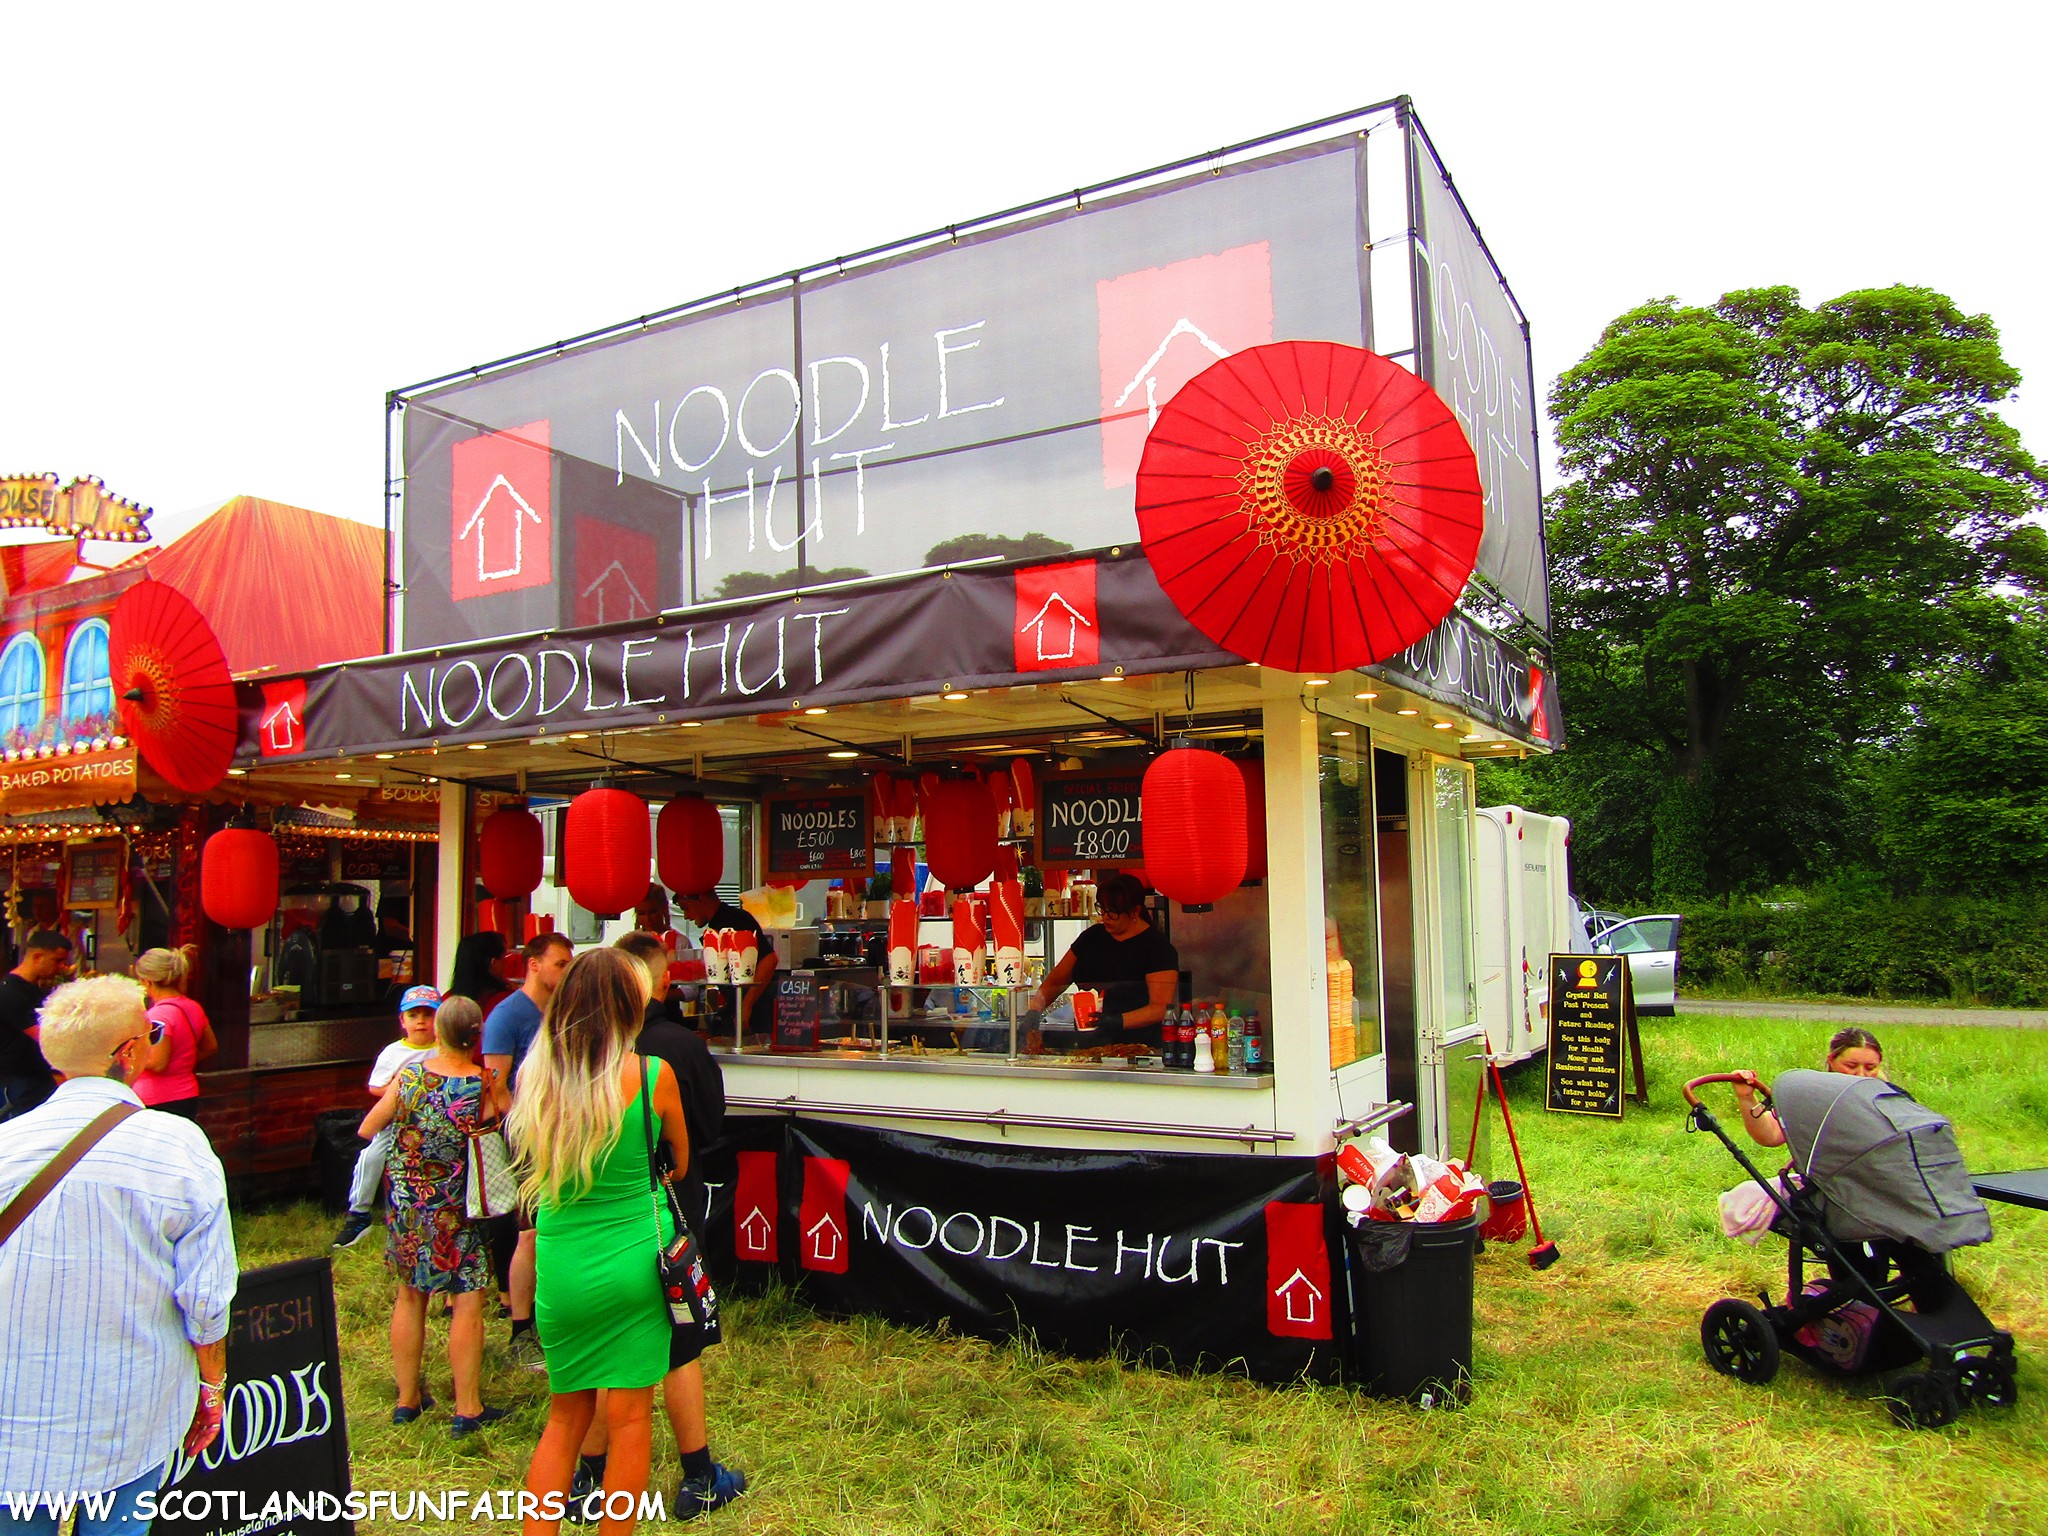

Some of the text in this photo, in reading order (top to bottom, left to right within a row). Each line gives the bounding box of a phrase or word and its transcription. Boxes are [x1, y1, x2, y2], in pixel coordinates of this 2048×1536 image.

[1416, 237, 1529, 471] NOODLE
[616, 320, 1005, 487] NOODLE
[1453, 377, 1508, 526] HUT
[703, 441, 896, 561] HUT
[402, 608, 850, 732] NOODLE HUT
[1482, 638, 1524, 722] HUT
[0, 759, 134, 791] BAKED POTATOES
[781, 810, 856, 831] NOODLES
[347, 862, 381, 876] COB
[781, 981, 809, 994] CASH
[1566, 992, 1590, 1000] Crystal
[1558, 1020, 1614, 1030] Future Readings
[1562, 1034, 1574, 1042] See
[1578, 1035, 1590, 1043] this
[1567, 1055, 1604, 1063] Money and
[1556, 1063, 1616, 1074] Business matters
[1560, 1078, 1608, 1088] See what the
[1563, 1088, 1606, 1098] future holds
[1570, 1098, 1598, 1108] for you
[863, 1201, 1243, 1285] NOODLE HUT
[229, 1296, 313, 1346] FRESH
